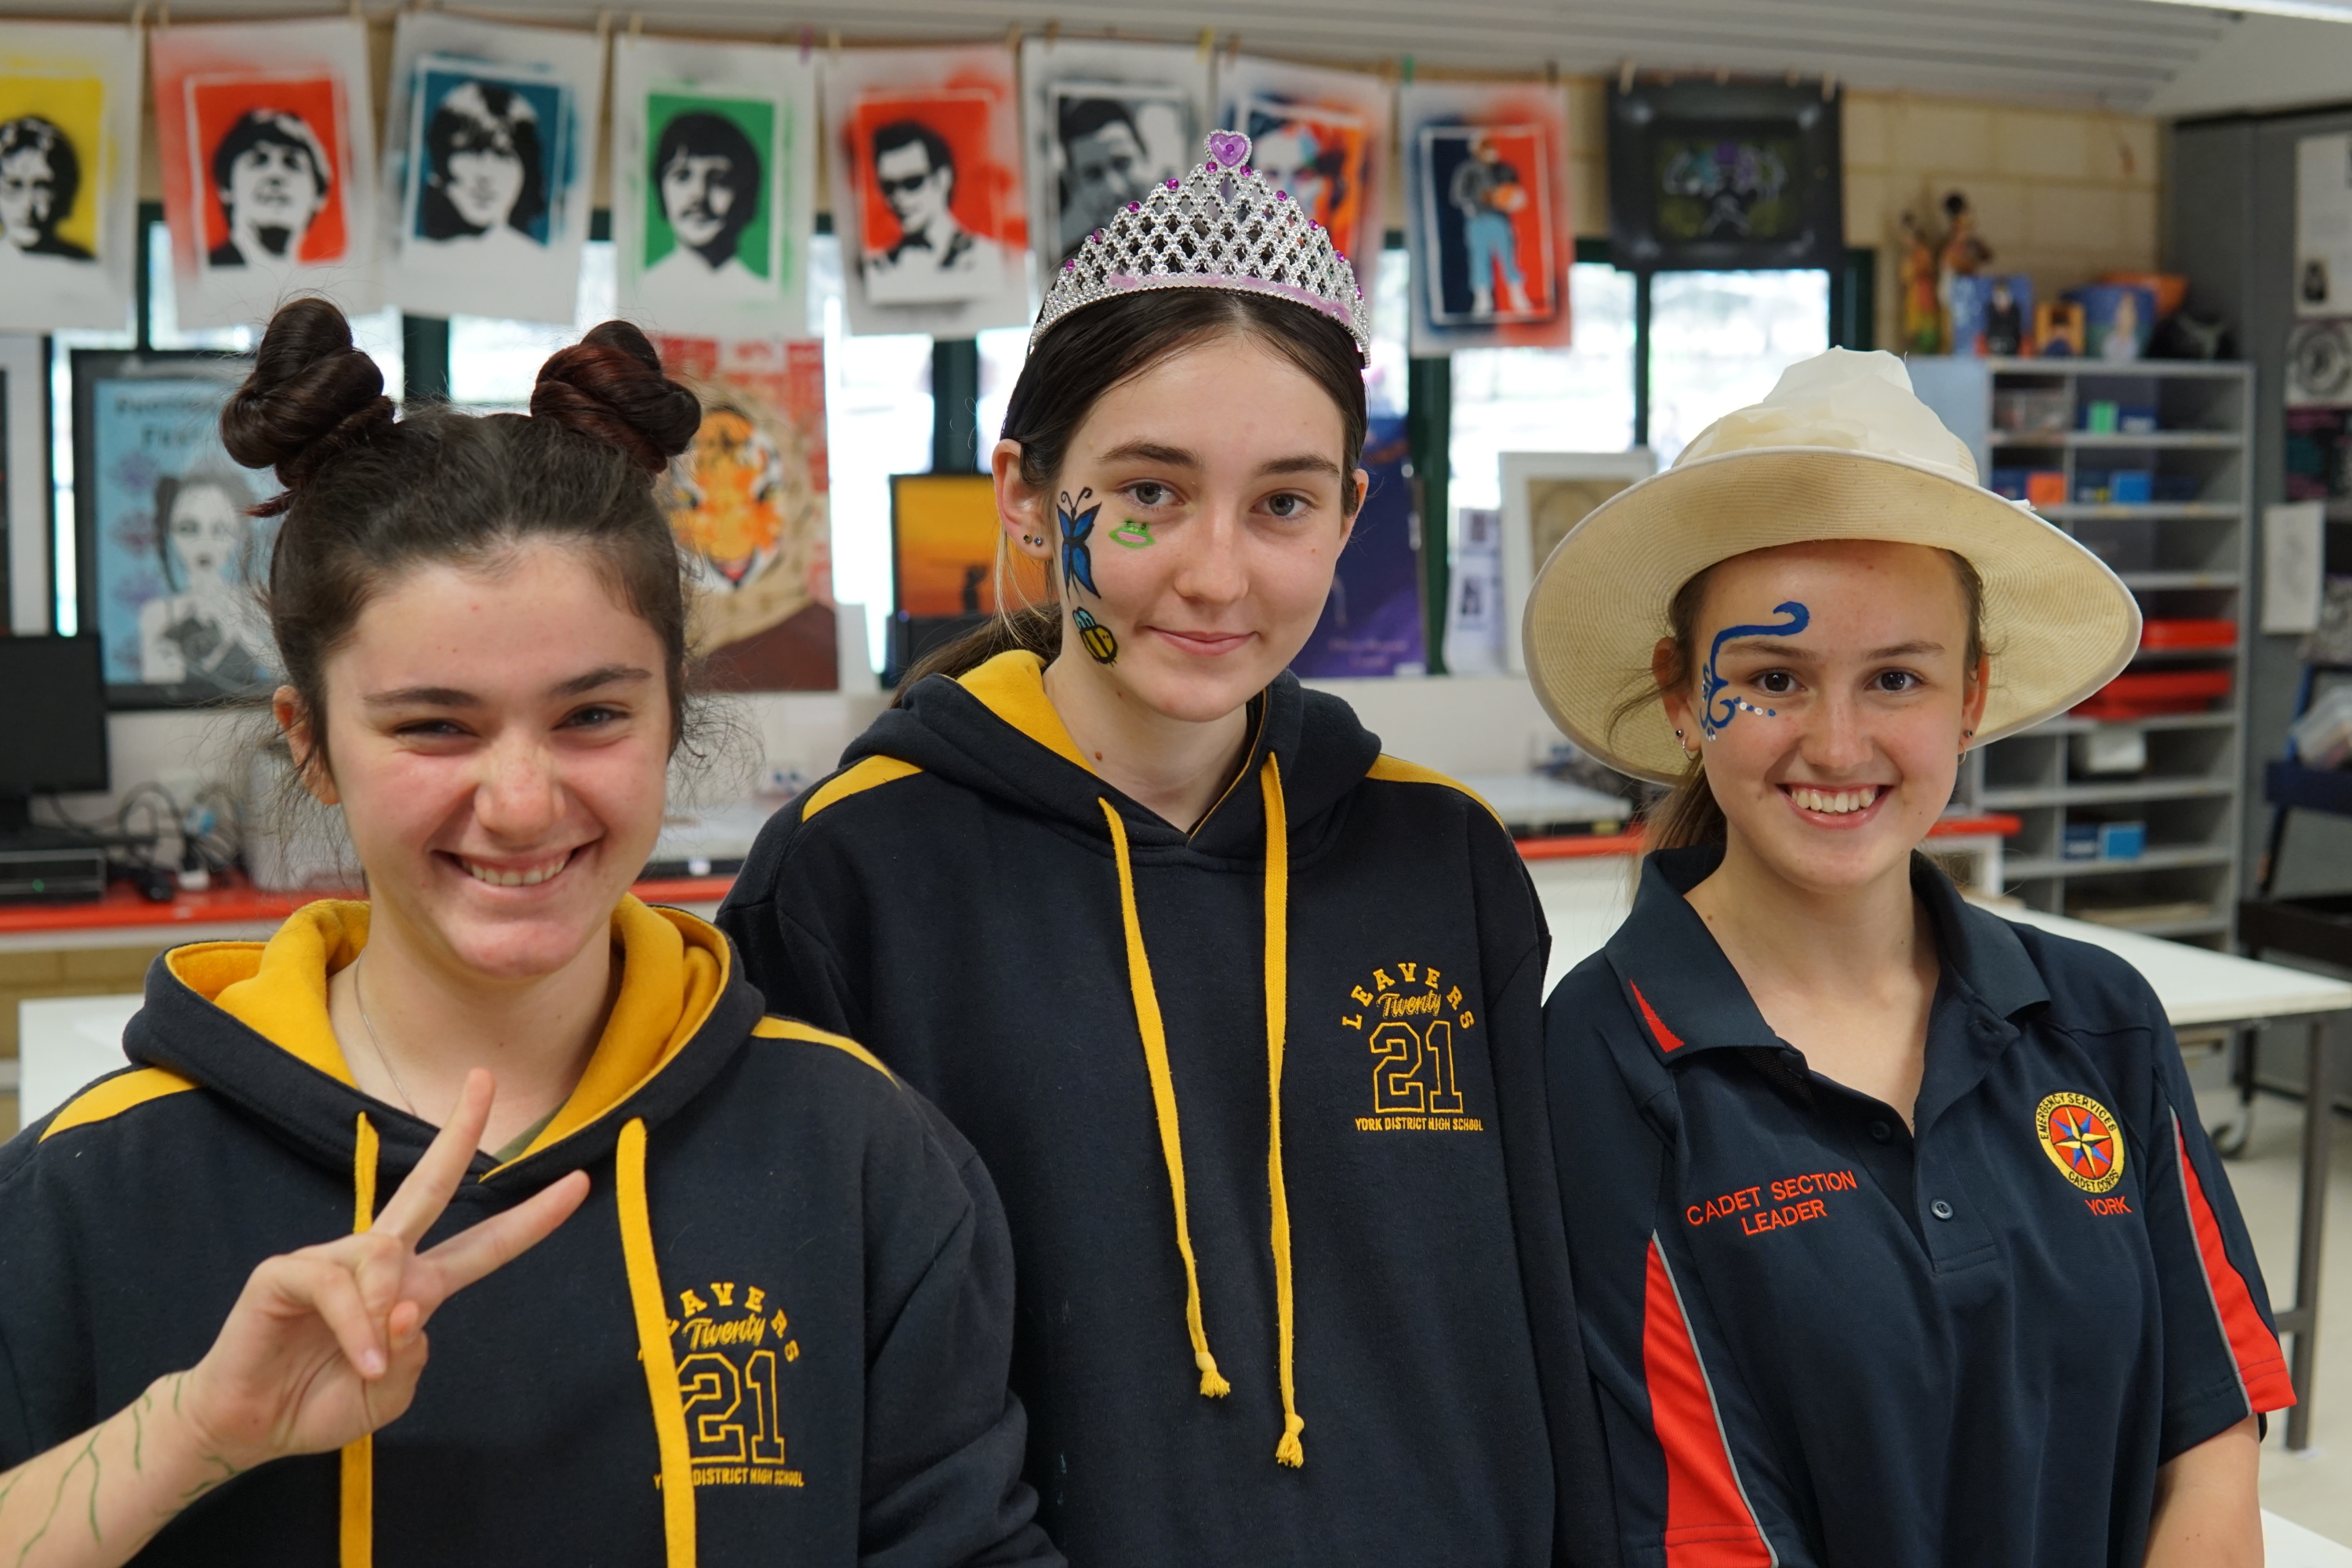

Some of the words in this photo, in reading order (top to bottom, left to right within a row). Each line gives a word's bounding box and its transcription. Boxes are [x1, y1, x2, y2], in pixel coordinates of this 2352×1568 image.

[1342, 963, 1475, 1029] LEAVERS
[1376, 989, 1442, 1018] Twenty
[1369, 1020, 1464, 1113] 21
[1355, 1118, 1383, 1131] YORK
[1385, 1117, 1428, 1131] DISTRICT
[1428, 1117, 1450, 1131] HIGH
[1452, 1118, 1484, 1131] SCHOOL
[2038, 1094, 2067, 1140] EMERGENCY
[2067, 1093, 2117, 1132] SERVICES
[1686, 1186, 1761, 1226] CADET
[1770, 1170, 1858, 1201] SECTION
[2069, 1171, 2096, 1192] CADET
[2096, 1169, 2119, 1193] CORPS
[1740, 1199, 1828, 1236] LEADER
[2084, 1196, 2133, 1216] YORK
[681, 1312, 767, 1351] Twenty
[676, 1349, 785, 1464] 21
[692, 1467, 750, 1486] DISTRICT
[750, 1467, 773, 1486] HIGH
[774, 1469, 805, 1487] SCHOOL
